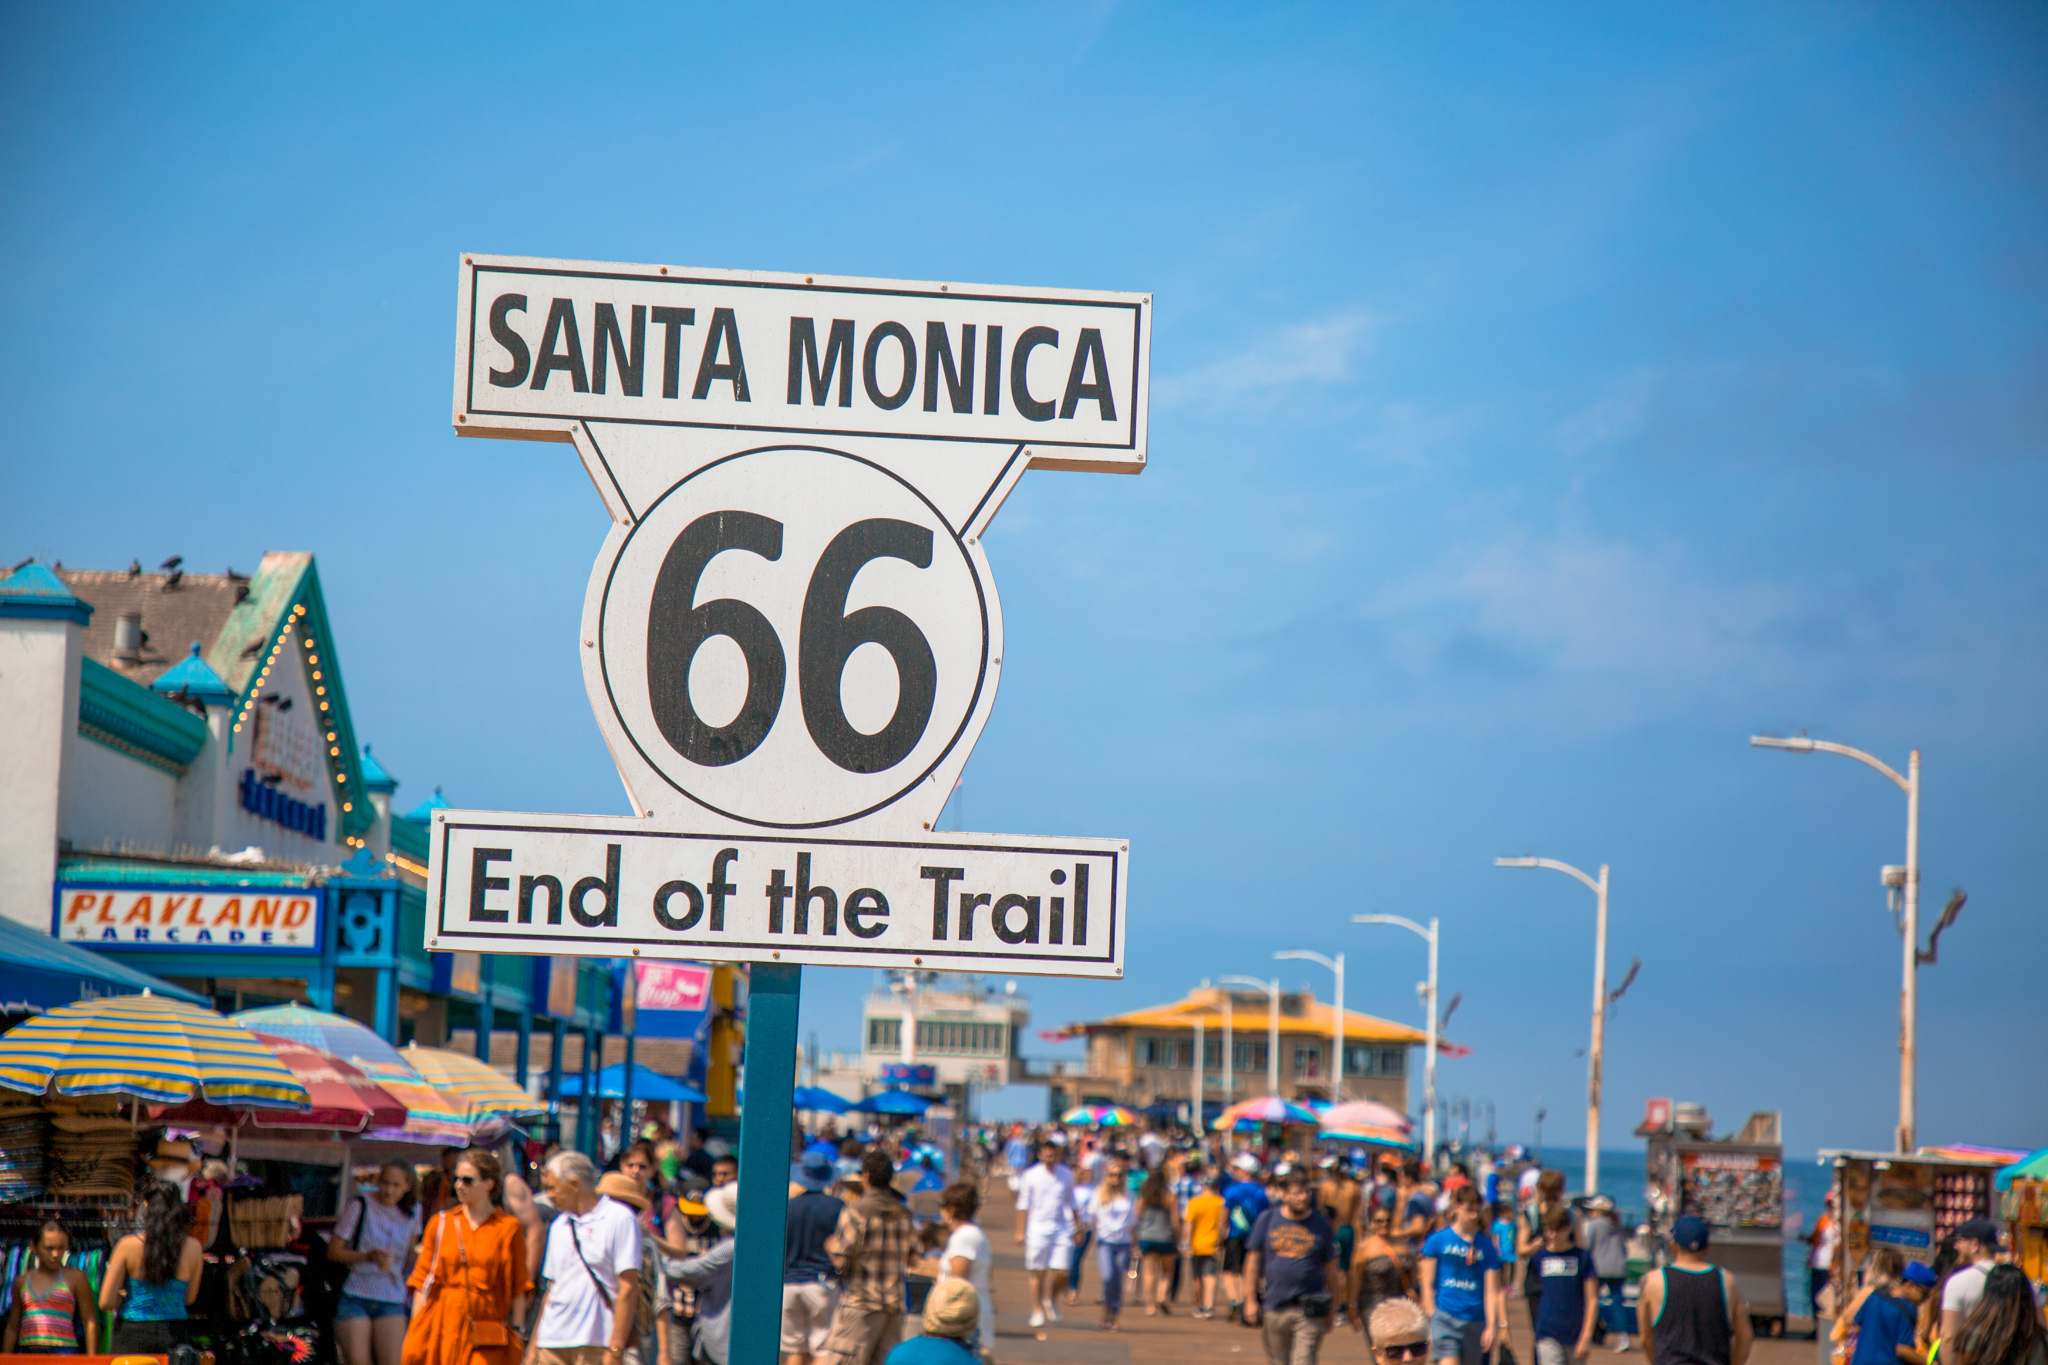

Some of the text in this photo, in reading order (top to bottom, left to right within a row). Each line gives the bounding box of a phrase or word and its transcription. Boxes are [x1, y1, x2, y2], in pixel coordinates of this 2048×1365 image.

[489, 294, 1117, 422] SANTA MONICA
[646, 510, 938, 774] 66
[65, 892, 311, 930] PLAYLAND
[101, 926, 274, 945] ARCADE
[469, 844, 1089, 945] End of the Trail
